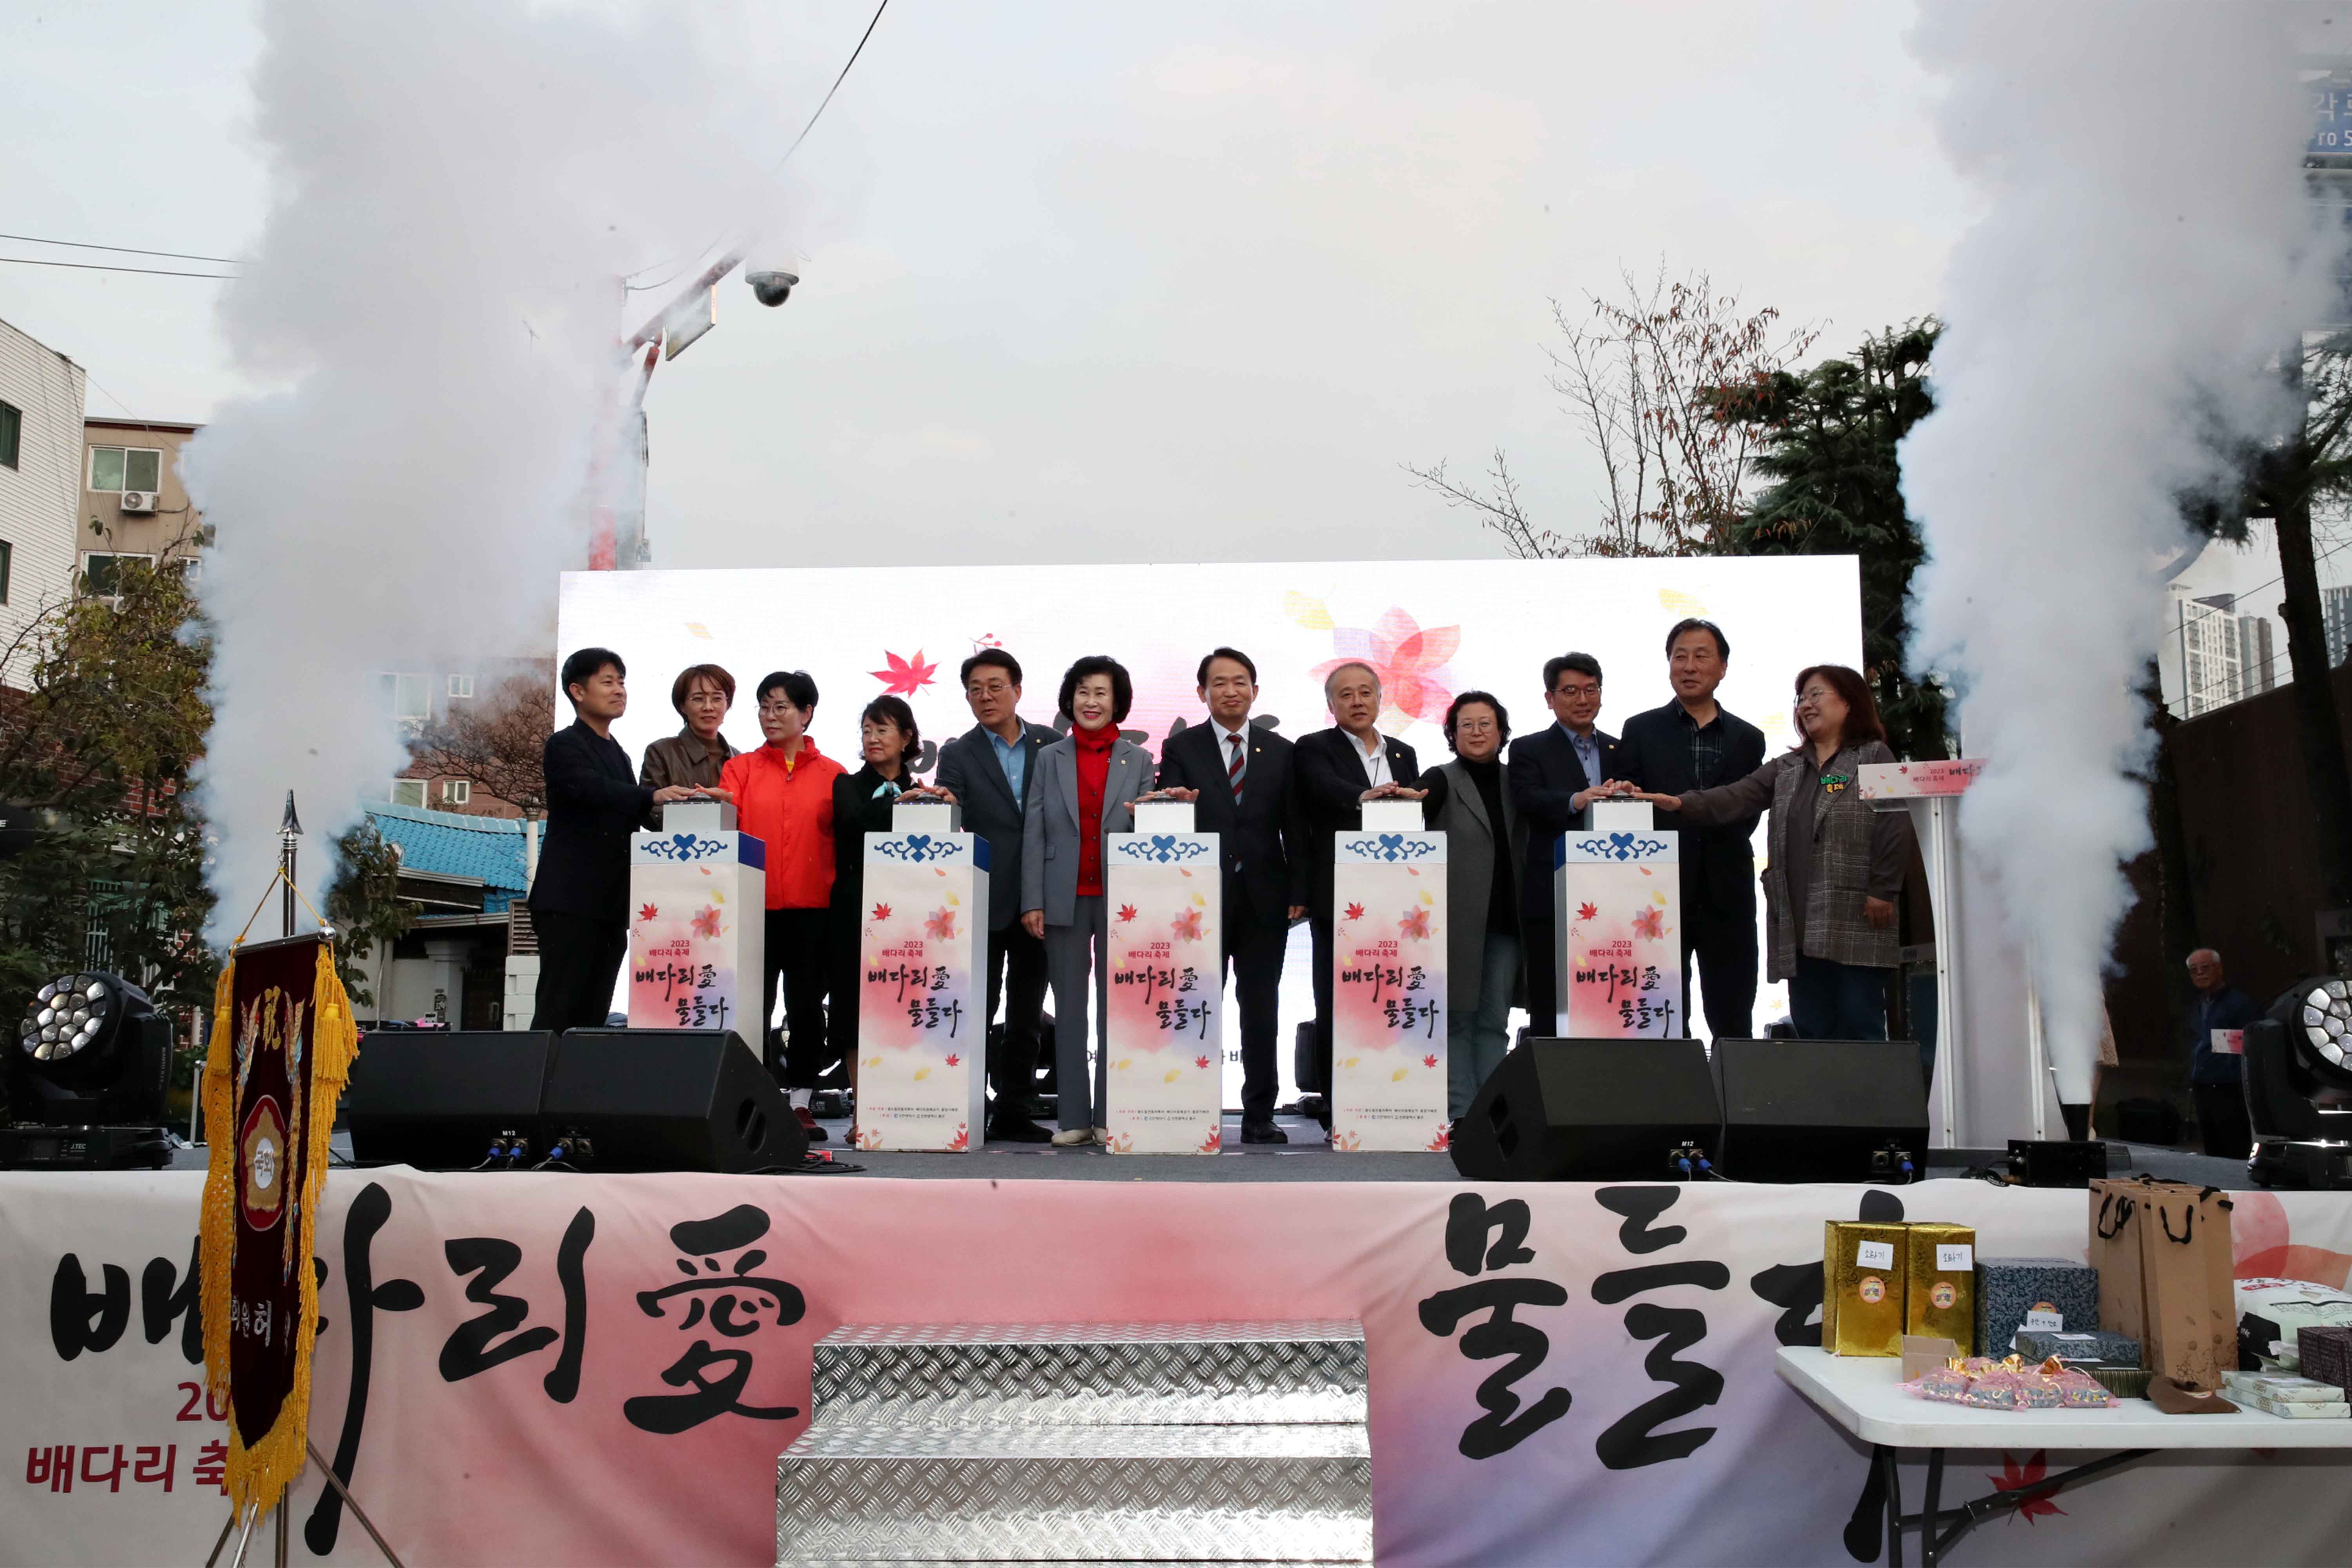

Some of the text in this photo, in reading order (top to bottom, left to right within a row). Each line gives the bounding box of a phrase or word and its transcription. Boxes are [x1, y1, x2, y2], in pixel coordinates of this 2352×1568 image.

[649, 948, 690, 957] 배다리 축제
[907, 949, 923, 958] 축제
[1355, 949, 1398, 957] 배다리 축제
[1589, 949, 1632, 957] 배다리 축제
[674, 996, 729, 1029] 물들다
[907, 998, 963, 1038] 물들다
[1156, 999, 1212, 1040] 물들다
[1384, 998, 1439, 1039] 물들다
[1619, 998, 1675, 1038] 물들다
[26, 1443, 176, 1493] 배다리
